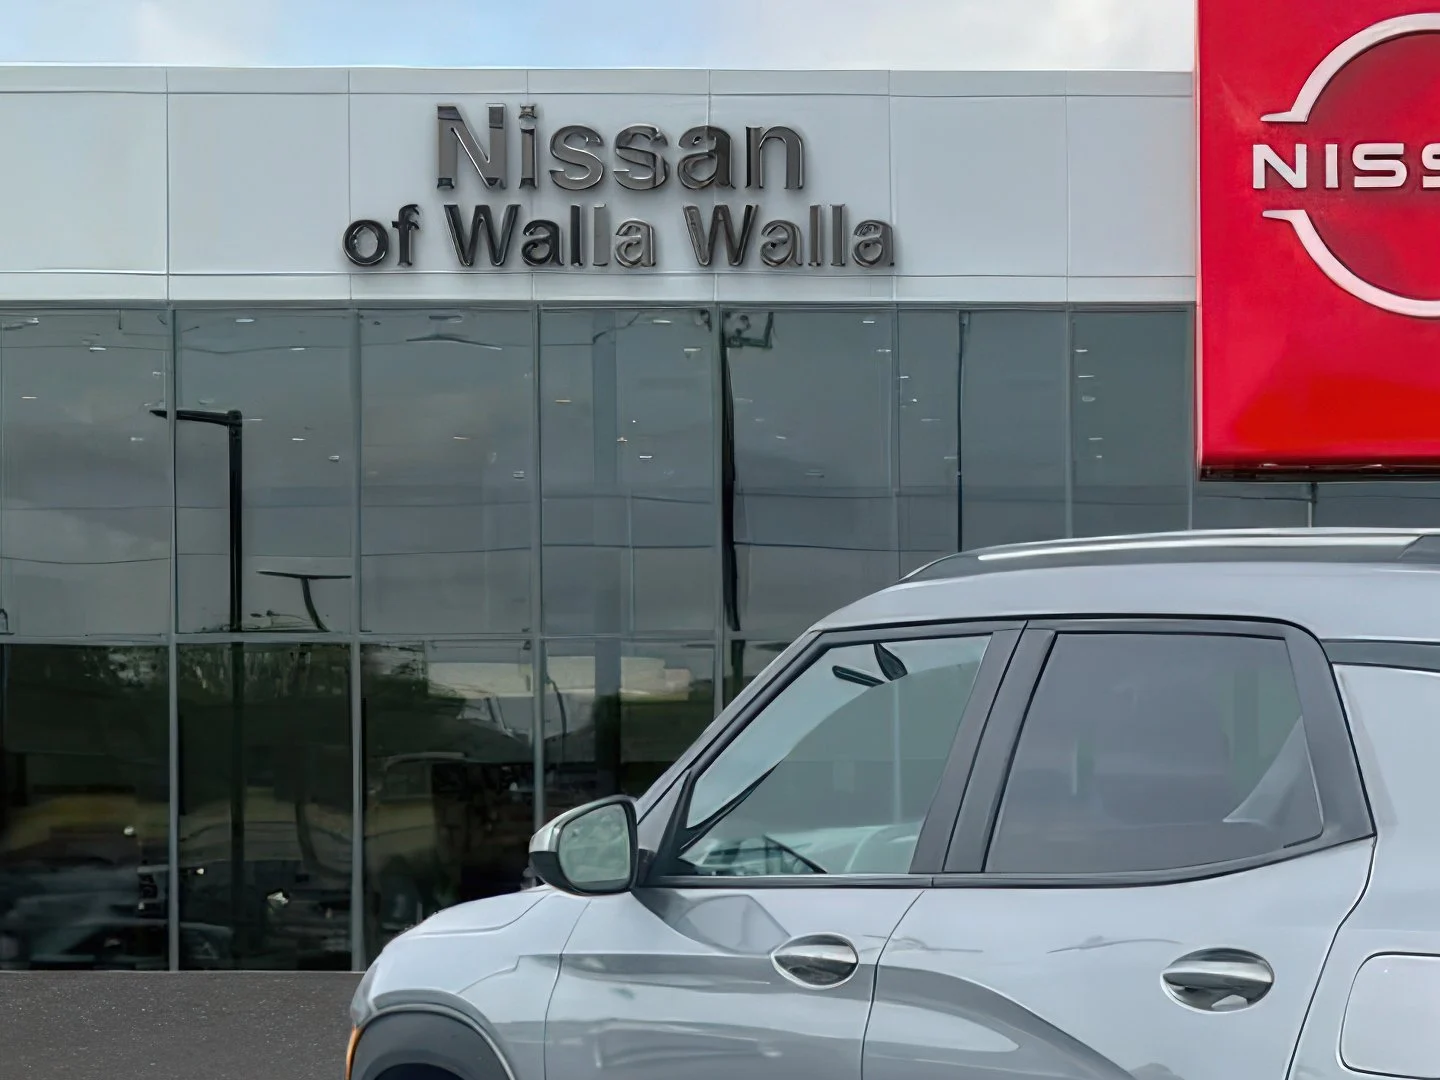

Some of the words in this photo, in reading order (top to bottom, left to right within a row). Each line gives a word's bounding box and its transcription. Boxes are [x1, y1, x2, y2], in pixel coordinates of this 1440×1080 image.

[436, 103, 805, 190] Nissan
[343, 204, 421, 267] of
[444, 204, 656, 267] Walla
[683, 204, 895, 267] Walla
